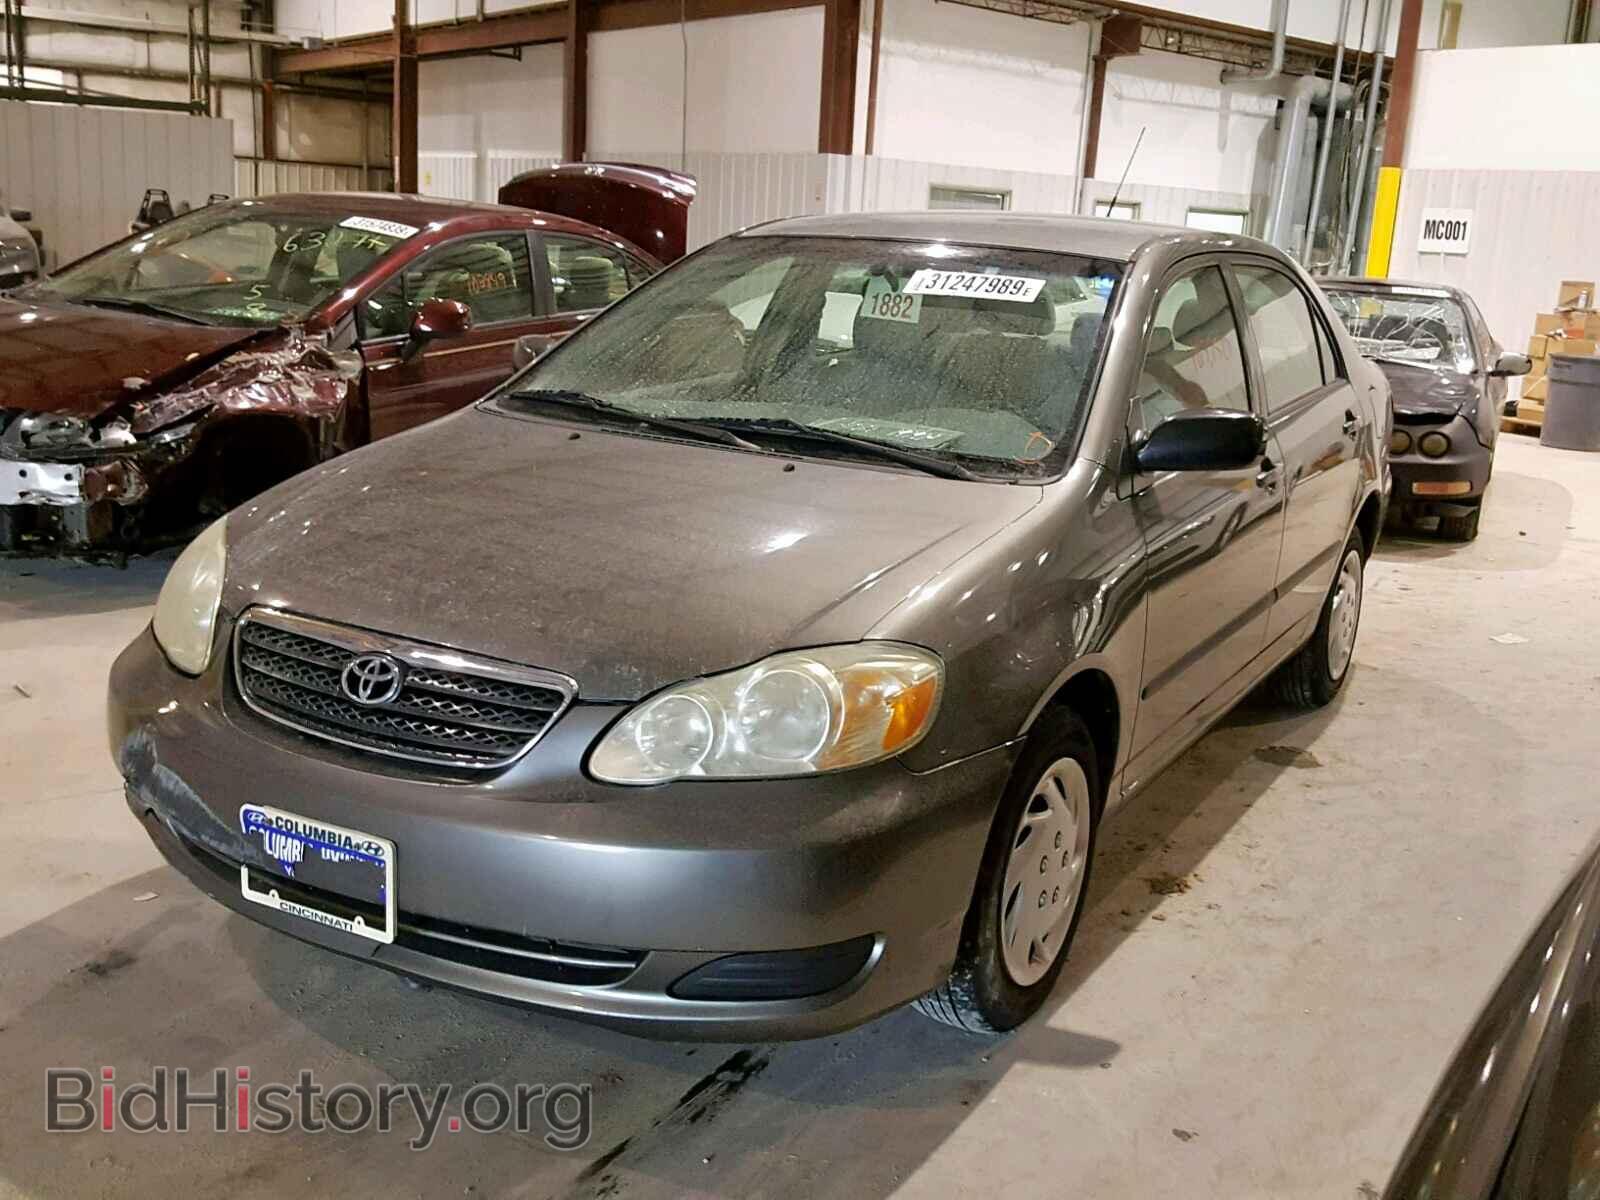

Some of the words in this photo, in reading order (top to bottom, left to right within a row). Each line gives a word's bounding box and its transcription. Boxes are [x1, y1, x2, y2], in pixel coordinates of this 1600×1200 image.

[1423, 219, 1467, 240] MC001
[925, 272, 1026, 296] 31247989
[871, 291, 913, 319] 1882
[275, 816, 353, 850] COLUMBIA
[279, 902, 354, 932] CINCINNATI
